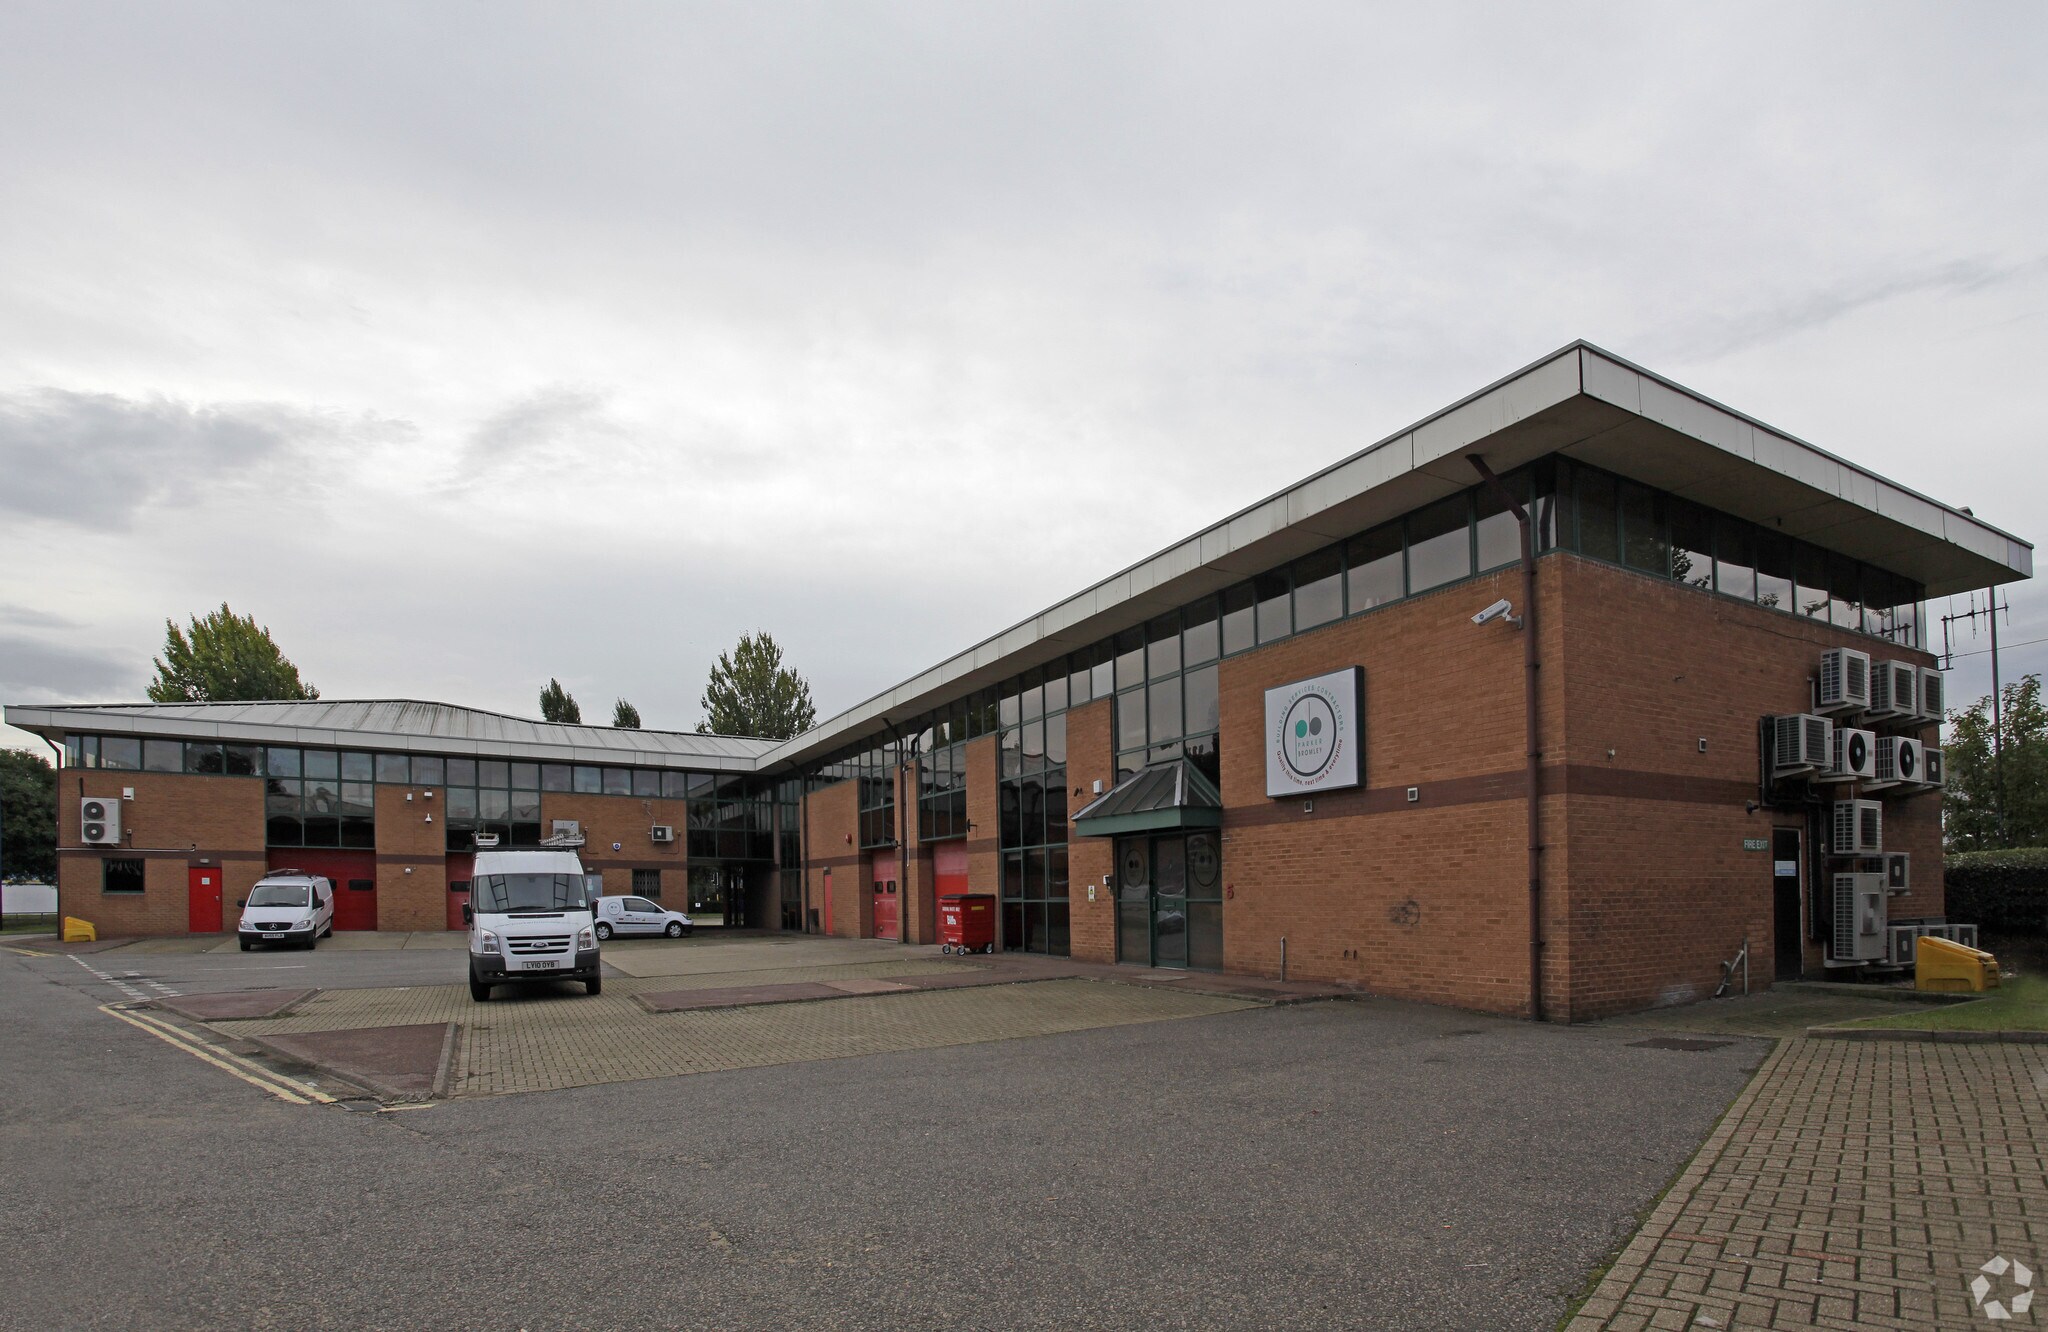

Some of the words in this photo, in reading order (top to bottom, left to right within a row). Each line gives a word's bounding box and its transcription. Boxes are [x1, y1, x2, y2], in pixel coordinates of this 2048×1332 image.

[1276, 705, 1288, 743] BUILDING
[1288, 685, 1314, 704] SERVICES
[1317, 686, 1344, 731] CONTRACTORS
[1298, 738, 1322, 747] PARKER
[1298, 748, 1322, 757] BROMLEY
[1277, 750, 1286, 771] Quality
[1285, 770, 1293, 780] this
[1329, 739, 1343, 770] everytime
[1744, 839, 1756, 849] FIRE
[1756, 840, 1768, 849] EXIT
